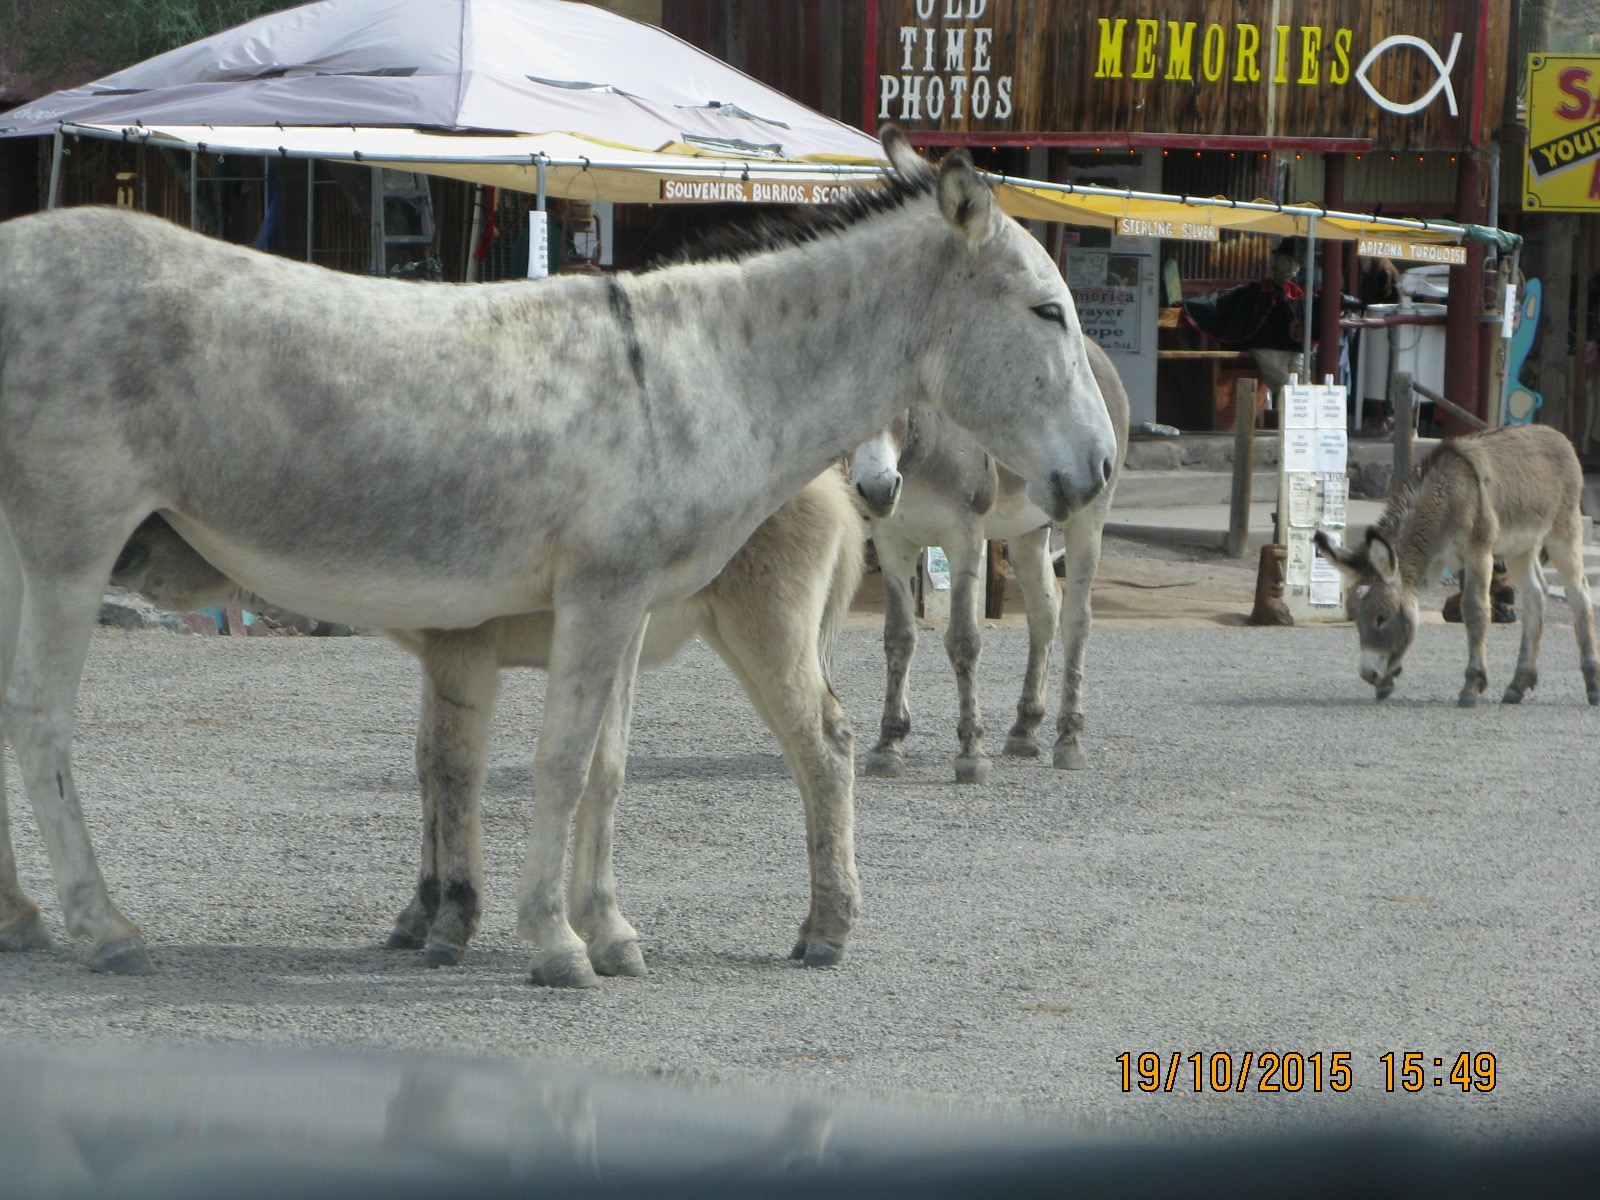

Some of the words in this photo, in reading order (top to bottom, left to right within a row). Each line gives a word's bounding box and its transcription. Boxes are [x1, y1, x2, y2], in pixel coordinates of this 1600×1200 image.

[900, 26, 992, 71] TIME
[1094, 18, 1353, 85] MEMORIES
[878, 74, 1013, 119] PHOTOS
[665, 180, 747, 202] SOUVENIRS,
[752, 184, 808, 203] BURROS,
[1122, 218, 1173, 237] STERLING
[1181, 223, 1216, 239] SILVER
[1359, 241, 1403, 257] ARIZONA
[1409, 244, 1466, 263] TURQUOISE
[1079, 308, 1125, 319] rayer
[1086, 328, 1125, 340] ope
